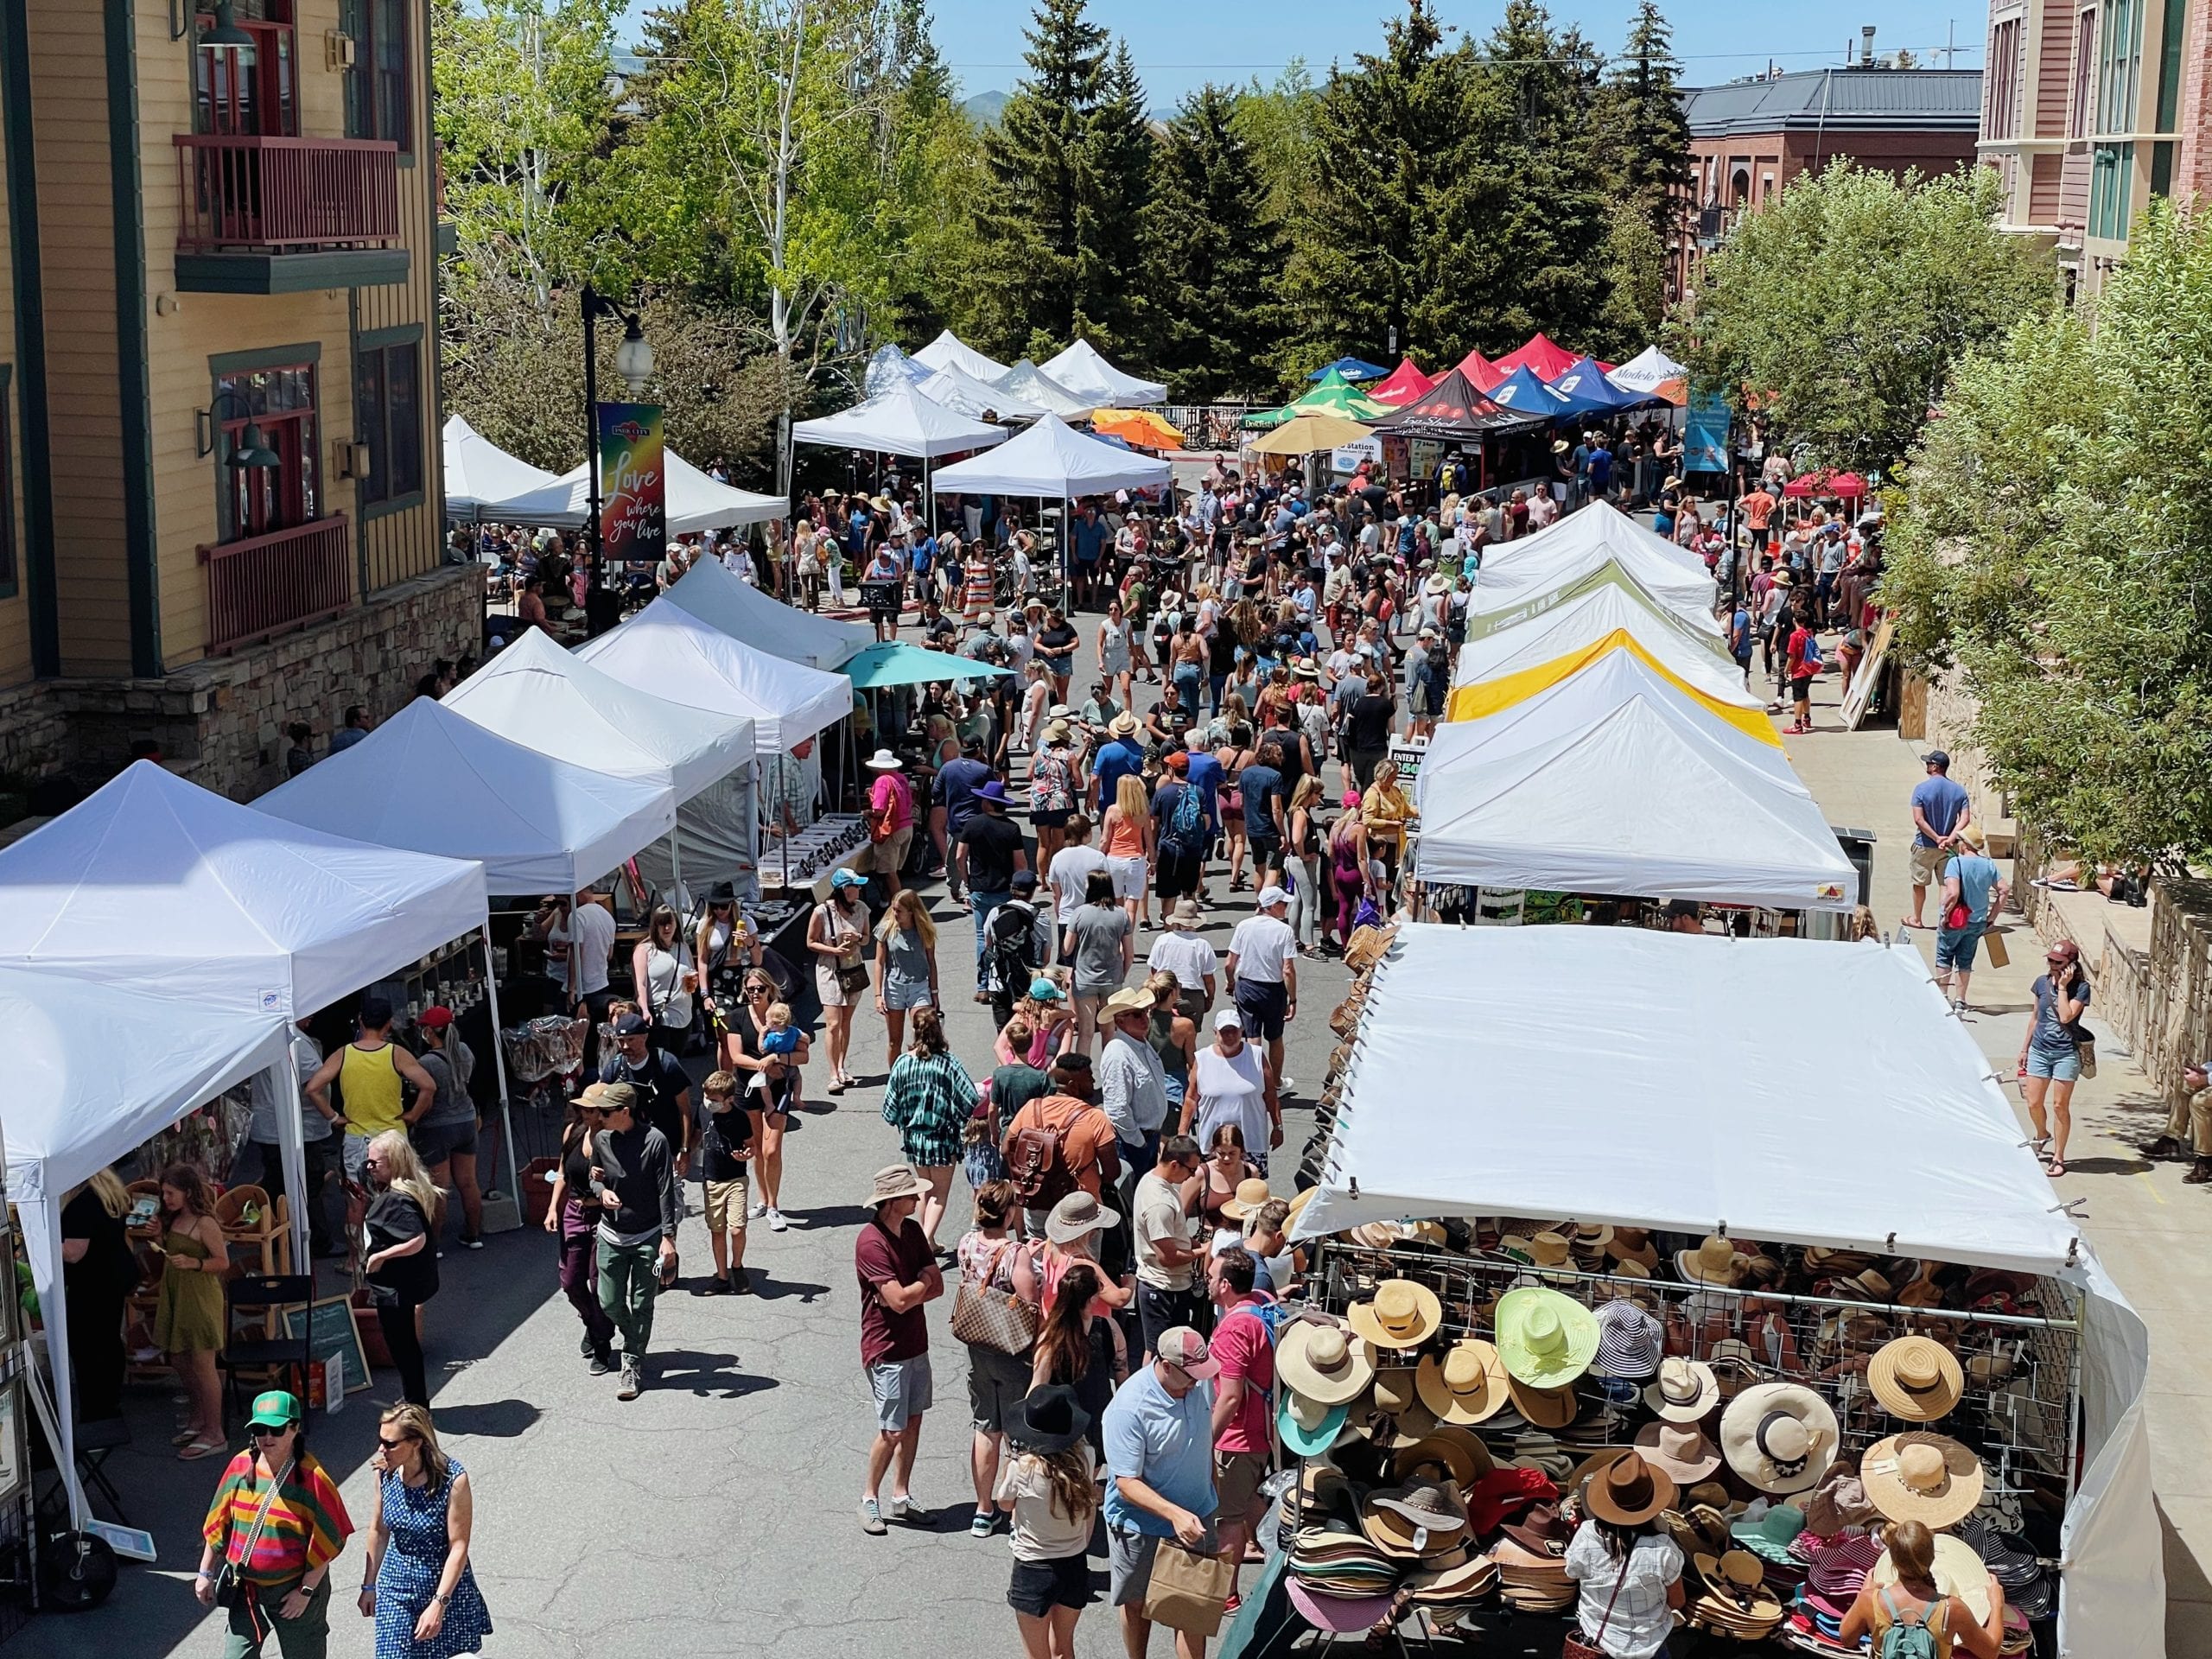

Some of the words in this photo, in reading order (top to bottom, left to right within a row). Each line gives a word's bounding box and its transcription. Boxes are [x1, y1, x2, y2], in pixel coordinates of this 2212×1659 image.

[1614, 368, 1655, 382] Modelo
[1245, 419, 1273, 429] Dogfish
[1402, 416, 1422, 425] Top
[1422, 416, 1460, 428] Shelf
[1414, 440, 1421, 448] 7
[601, 451, 658, 510] Love
[626, 497, 661, 517] where
[609, 519, 637, 543] you
[637, 518, 661, 539] live
[1394, 753, 1414, 762] ENTER
